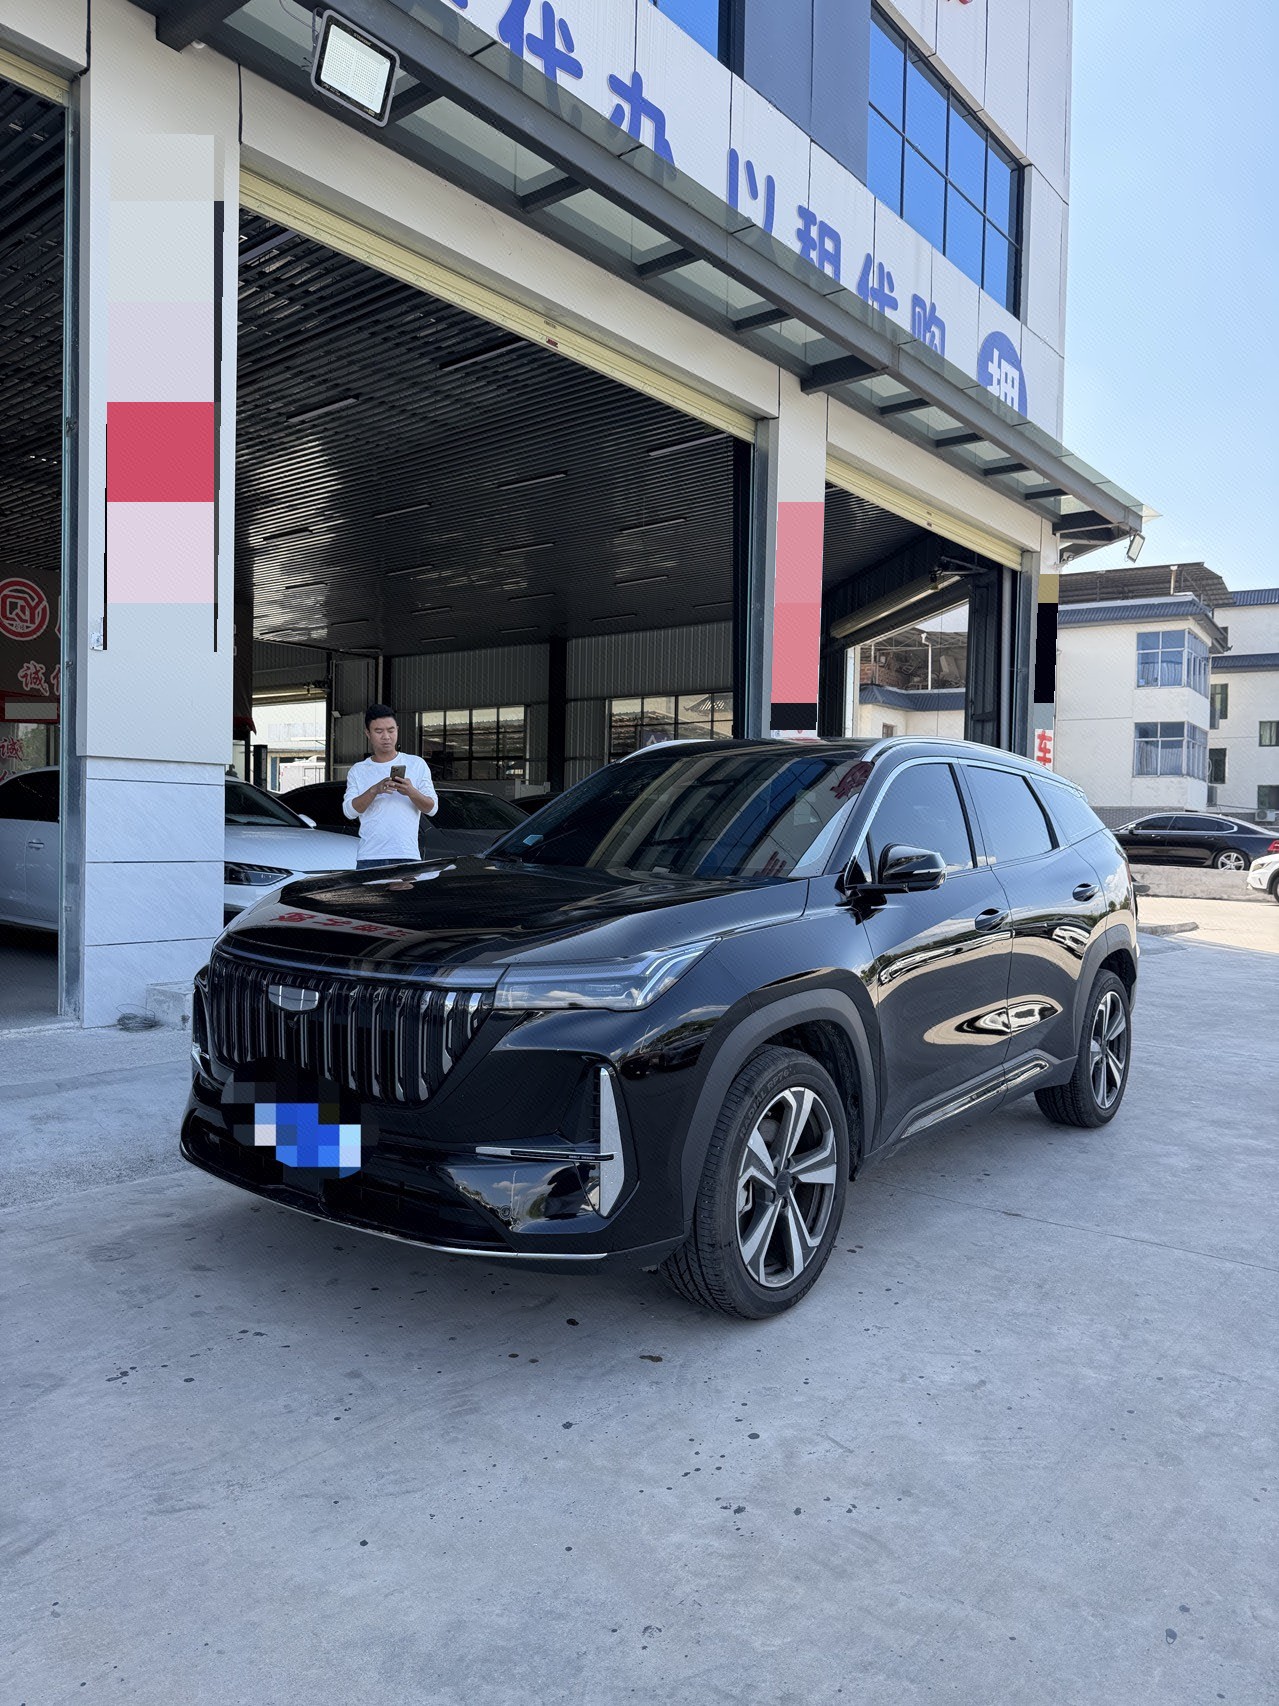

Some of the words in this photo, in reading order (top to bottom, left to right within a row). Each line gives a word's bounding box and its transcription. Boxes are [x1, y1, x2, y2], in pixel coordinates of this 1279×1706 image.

[452, 0, 678, 172] 代办
[726, 147, 947, 359] 以租代购
[1035, 729, 1053, 767] 车
